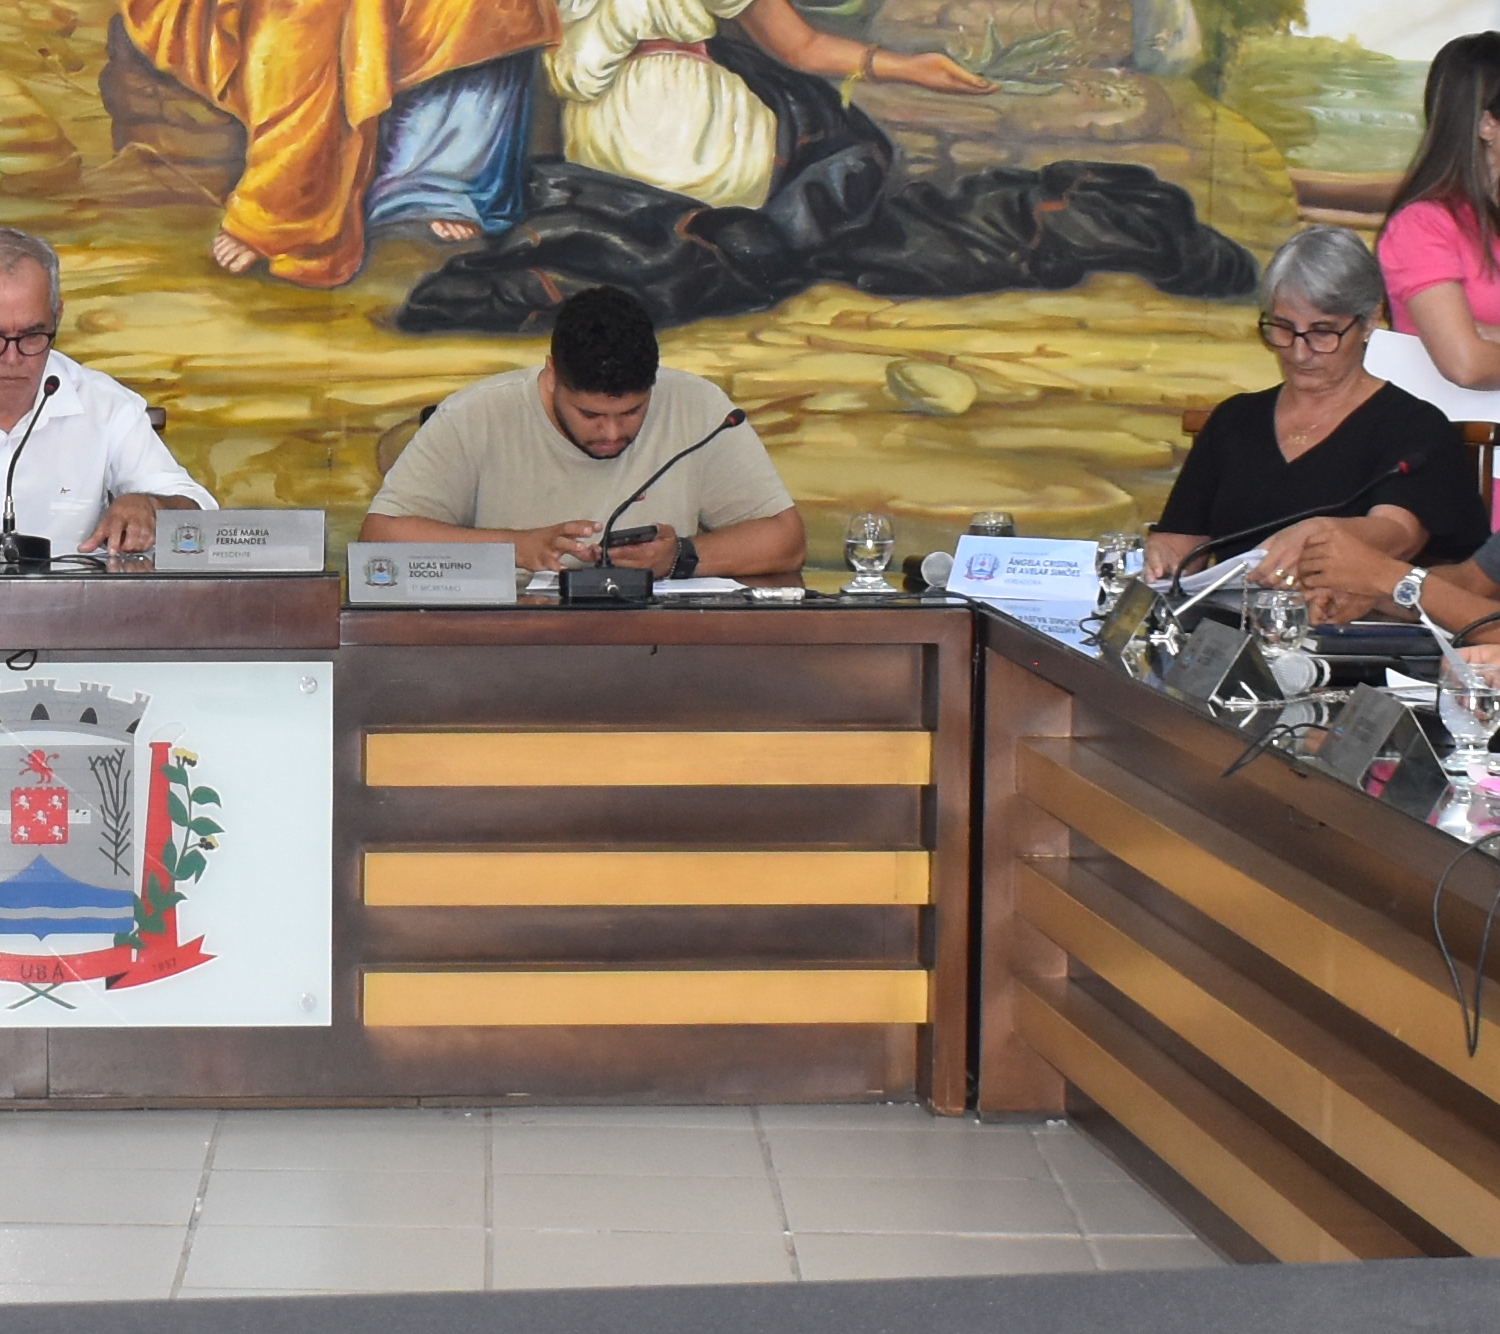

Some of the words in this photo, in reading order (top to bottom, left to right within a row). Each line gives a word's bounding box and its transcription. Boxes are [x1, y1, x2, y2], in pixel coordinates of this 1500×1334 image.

[215, 527, 238, 536] JOSÉ
[240, 528, 270, 536] MARIA
[215, 537, 267, 545] FERNANDES
[408, 562, 437, 570] LUCAS
[439, 562, 472, 570] RUFINO
